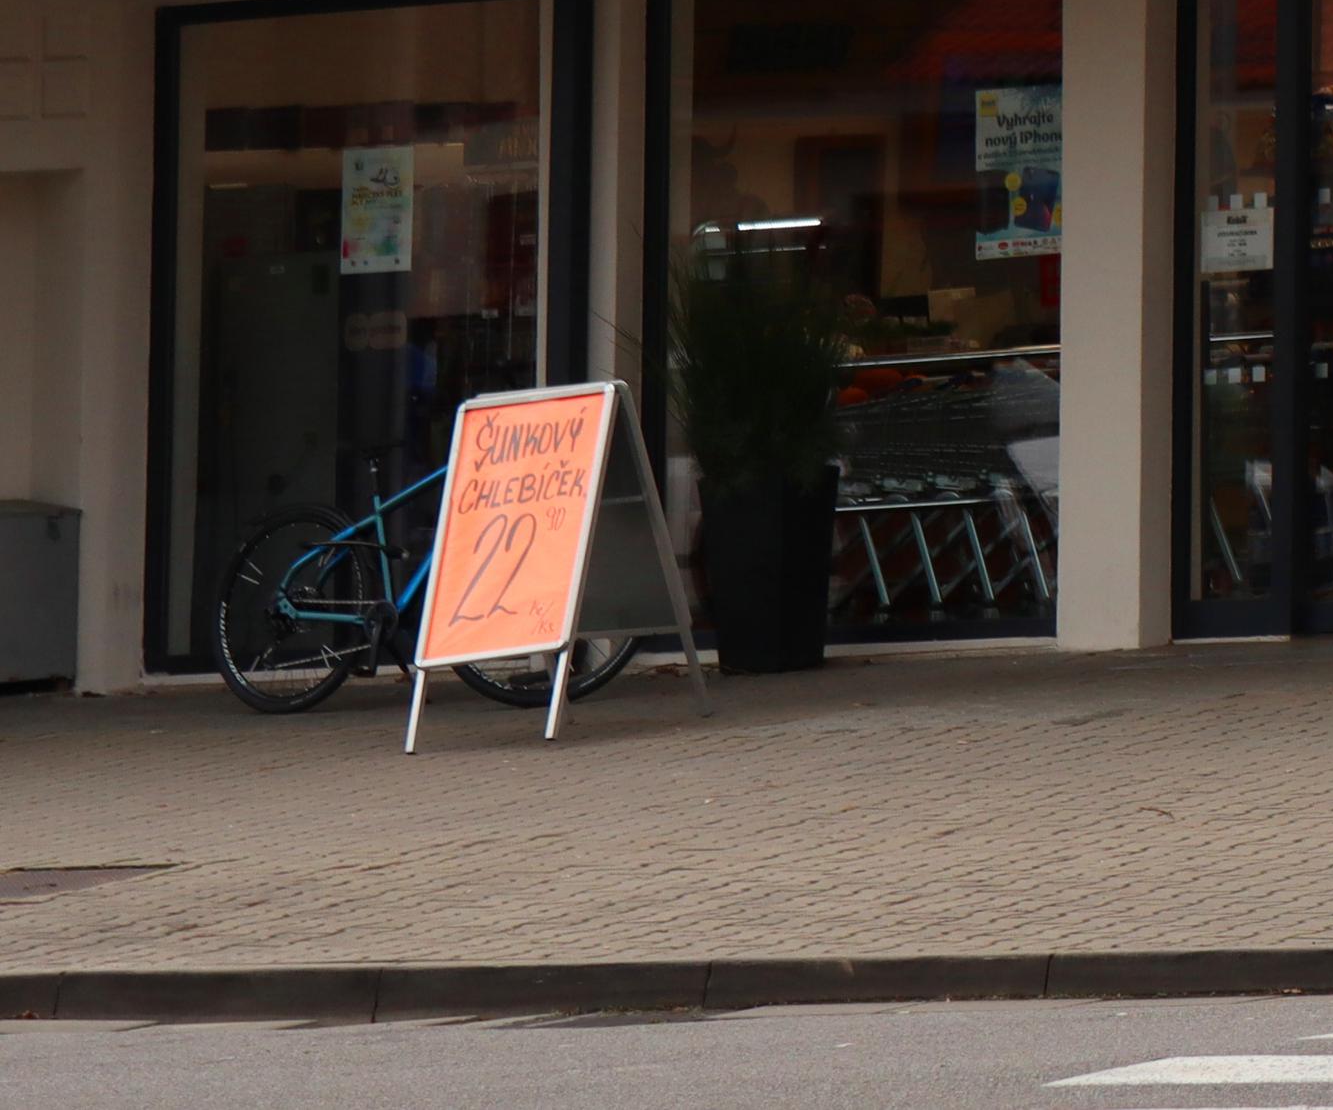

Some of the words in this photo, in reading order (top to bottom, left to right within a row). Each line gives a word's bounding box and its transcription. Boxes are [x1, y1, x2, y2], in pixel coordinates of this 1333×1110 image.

[997, 112, 1054, 131] Vyhrajte
[474, 405, 588, 473] ŠUNKOVÝ
[448, 512, 538, 628] 22
